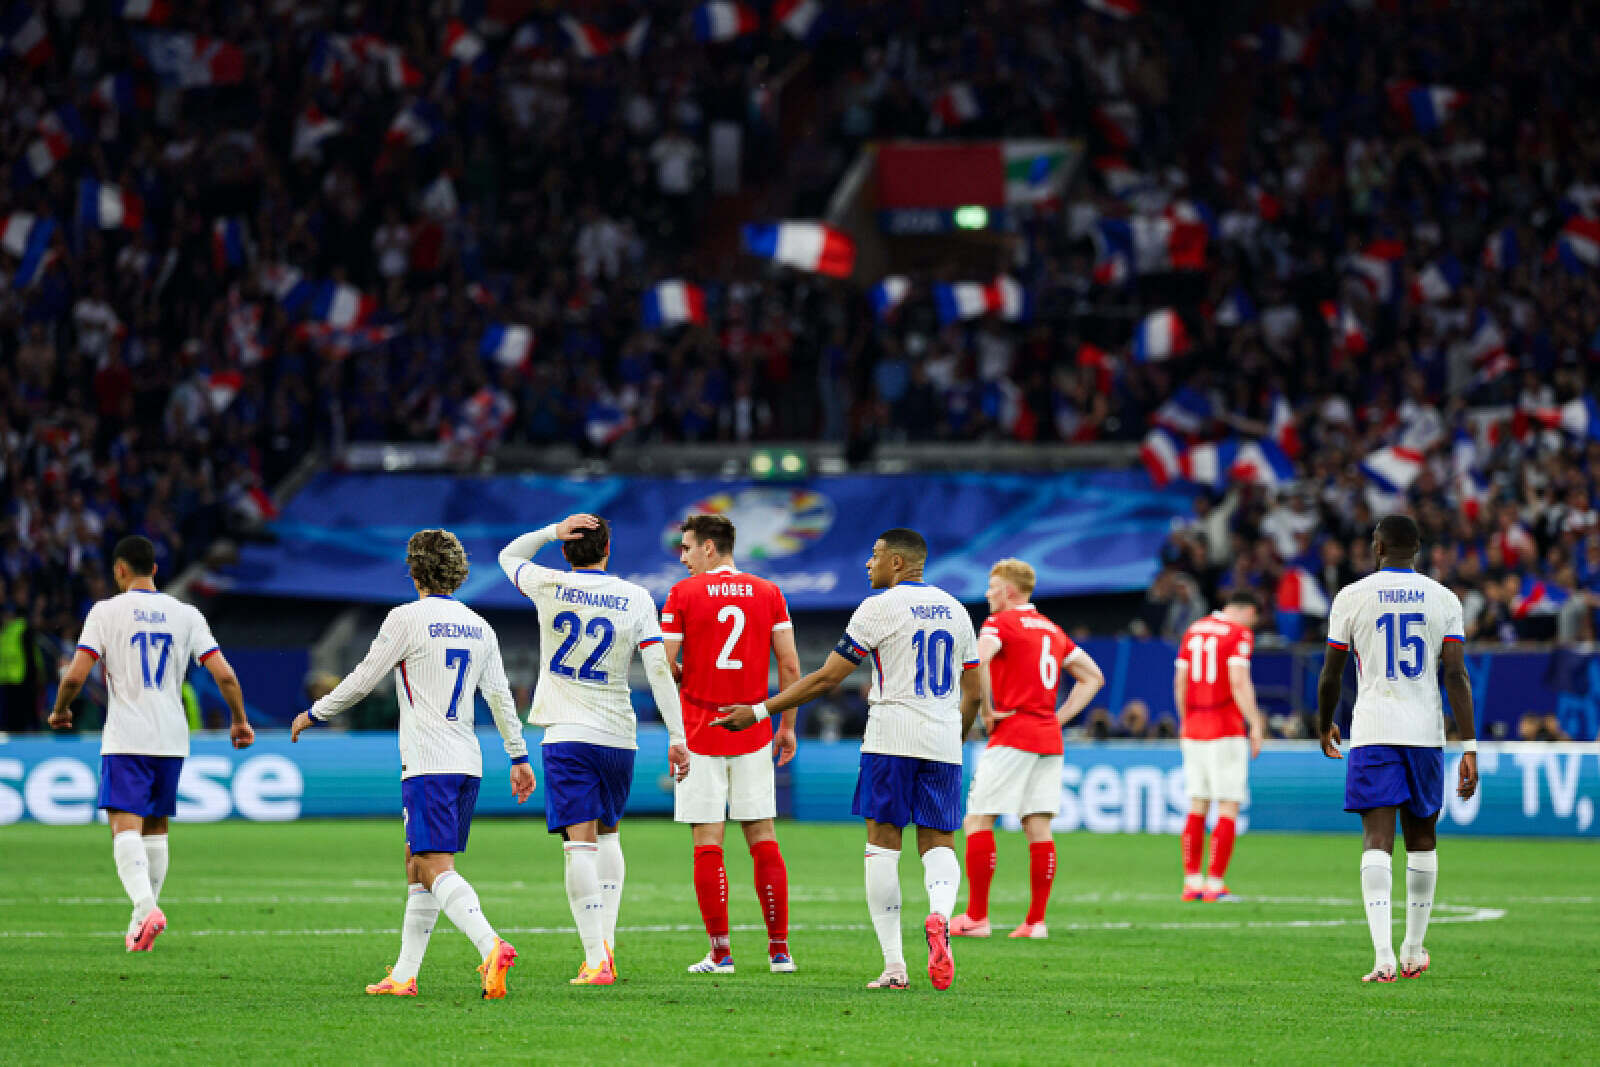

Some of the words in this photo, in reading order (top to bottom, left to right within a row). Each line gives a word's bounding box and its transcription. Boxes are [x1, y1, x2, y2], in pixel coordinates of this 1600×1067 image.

[1377, 589, 1425, 603] THURAM
[130, 632, 173, 689] 17
[550, 611, 615, 684] 22
[716, 605, 745, 669] 2
[912, 629, 955, 699] 10
[1040, 635, 1058, 690] 6
[1188, 634, 1218, 683] 11
[1376, 613, 1426, 680] 15
[445, 649, 472, 721] 7
